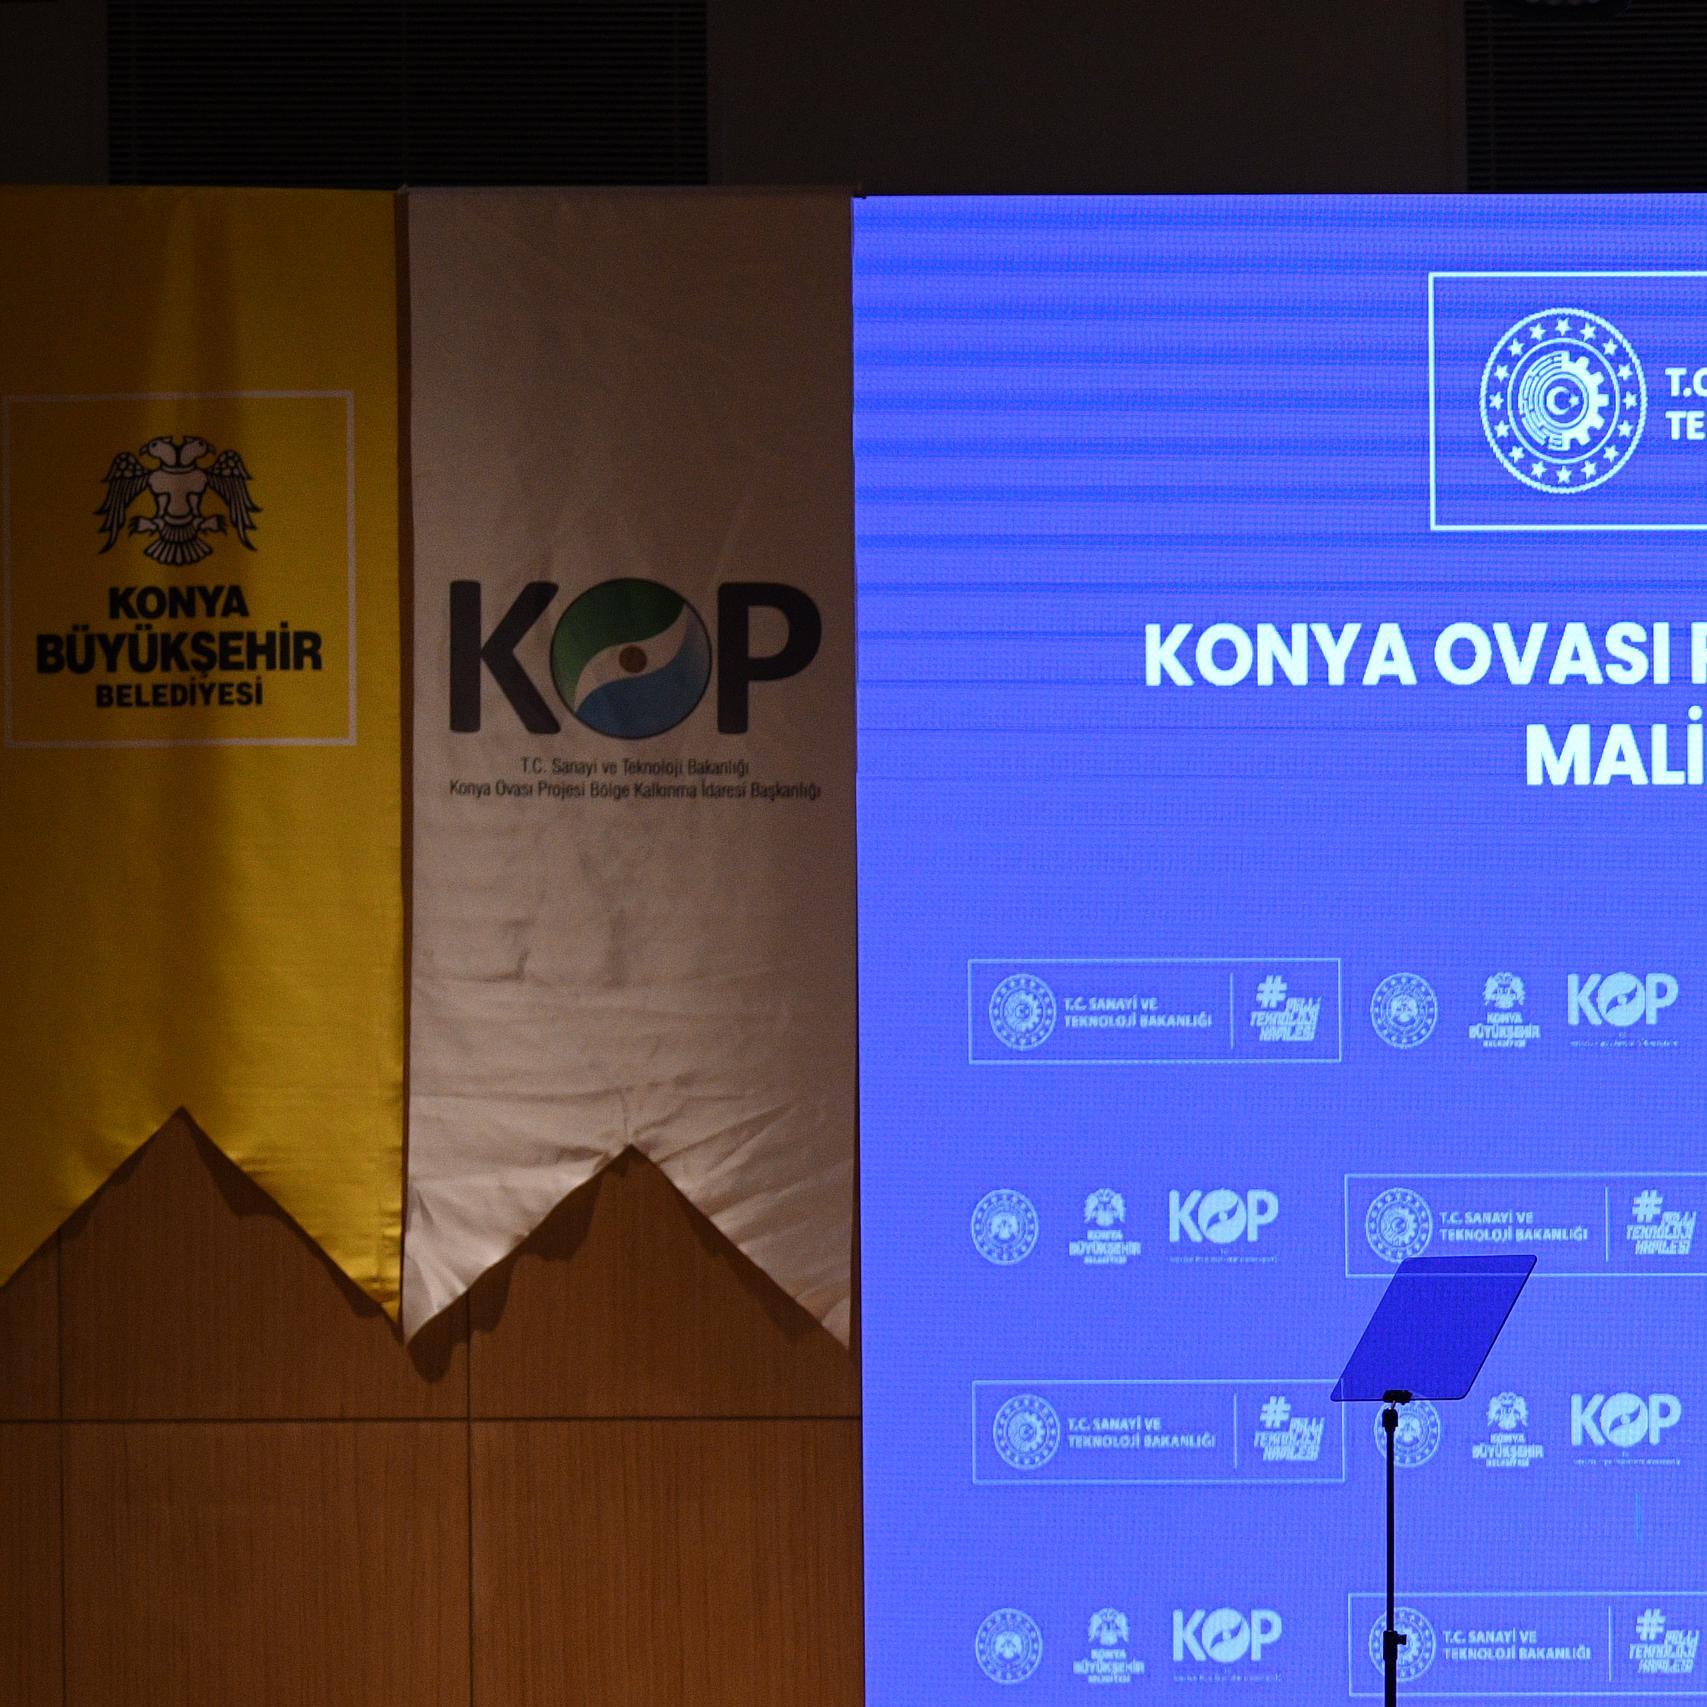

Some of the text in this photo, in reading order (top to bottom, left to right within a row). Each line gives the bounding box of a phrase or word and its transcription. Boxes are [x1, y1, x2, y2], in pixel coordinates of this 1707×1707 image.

[108, 585, 250, 620] KONYA
[36, 622, 323, 680] BÜYÜKŞEHİR
[449, 577, 823, 740] KOP
[1145, 622, 1417, 687] KONYA
[1435, 621, 1670, 686] OVASI
[95, 679, 263, 709] BELEDİYESİ
[1526, 706, 1704, 786] MALİ
[1065, 995, 1158, 1011] T.C. SANAYİ VE
[1065, 1011, 1212, 1028] TEKNOLOJİ BAKANLIĞI
[1568, 972, 1678, 1026] KOP
[1169, 1189, 1278, 1243] KOP
[1440, 1210, 1533, 1224] T.C. SANAYİ VE
[1440, 1225, 1588, 1242] TEKNOLOJİ BAKANLIĞI
[1571, 1393, 1681, 1447] KOP
[1173, 1608, 1282, 1662] KOP
[1443, 1628, 1536, 1643] T.C. SANAYİ VE
[1444, 1644, 1591, 1660] TEKNOLOJİ BAKANLIĞI
